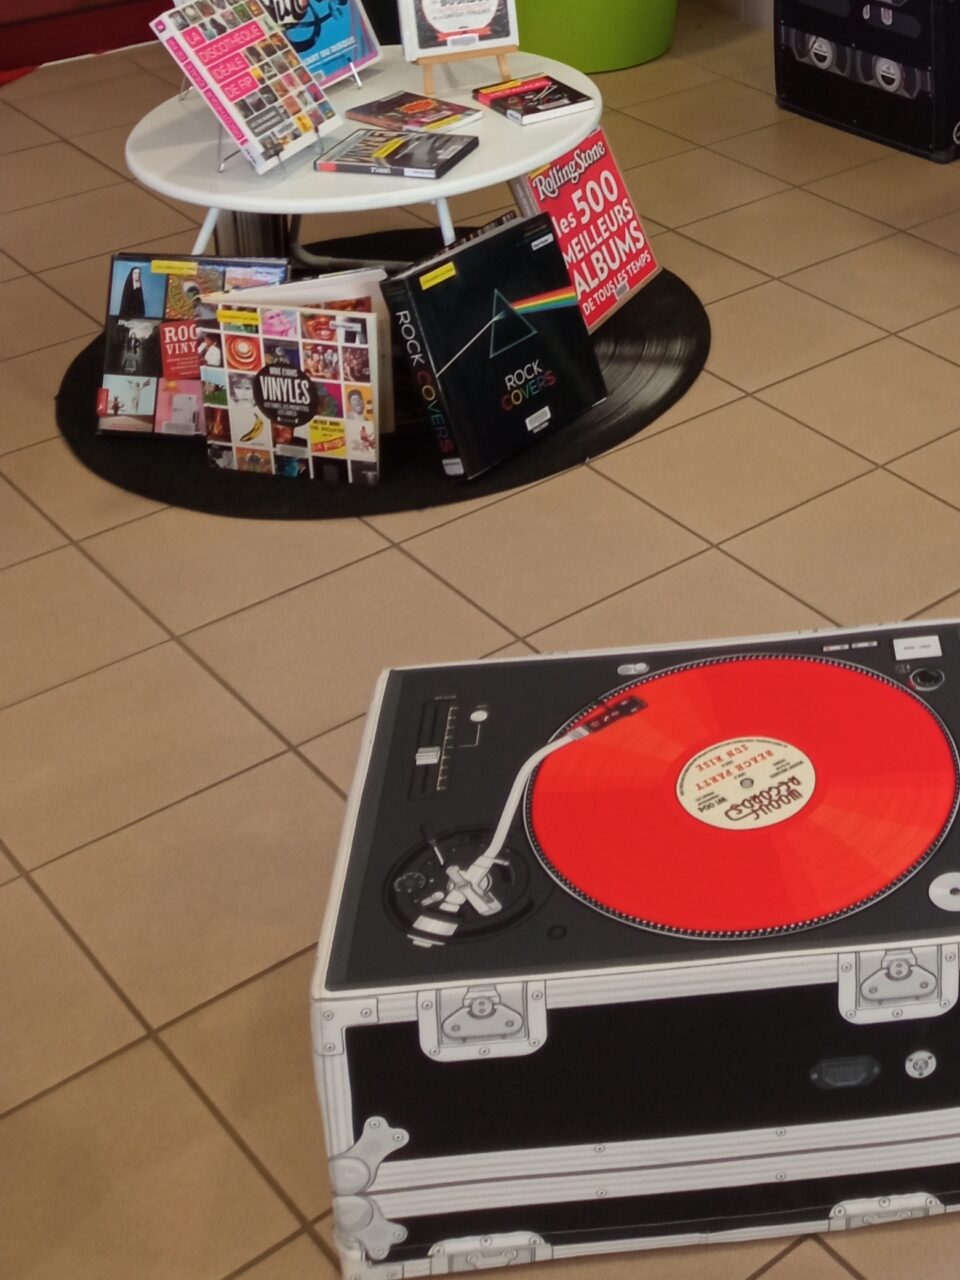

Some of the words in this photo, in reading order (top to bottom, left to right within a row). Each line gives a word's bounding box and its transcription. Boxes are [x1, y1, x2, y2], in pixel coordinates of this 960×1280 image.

[186, 31, 202, 47] LA
[574, 141, 606, 171] Stone
[551, 213, 577, 238] les
[571, 170, 619, 225] 500
[562, 198, 635, 267] MEILLEURS
[573, 220, 645, 301] ALBUMS
[582, 301, 596, 317] DE
[594, 282, 616, 307] TOUS
[613, 269, 629, 289] LES
[627, 250, 651, 278] TEMPS
[396, 310, 426, 367] ROCK
[260, 375, 310, 405] VINYLES
[501, 370, 556, 411] COVERS
[505, 359, 543, 391] ROCK
[416, 370, 455, 454] COVERS
[695, 755, 722, 772] RISE
[727, 744, 749, 759] SUN
[736, 749, 774, 772] BEACH
[695, 770, 733, 791] PARTY
